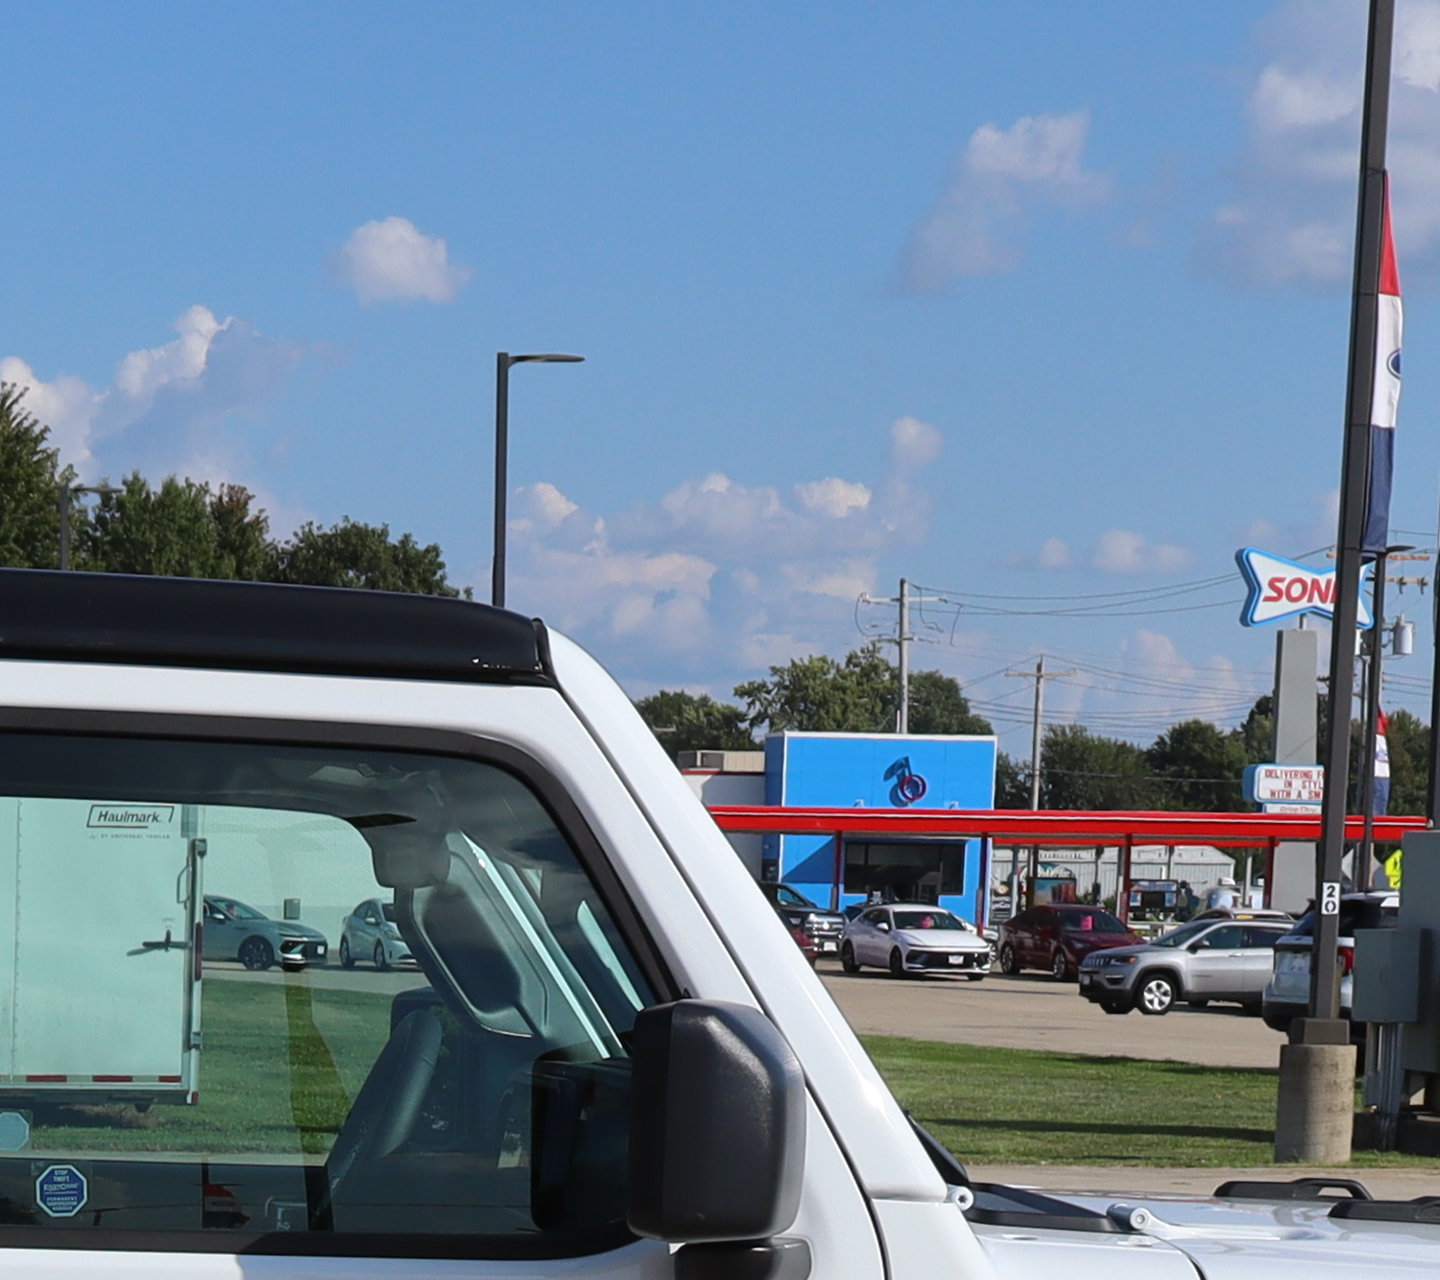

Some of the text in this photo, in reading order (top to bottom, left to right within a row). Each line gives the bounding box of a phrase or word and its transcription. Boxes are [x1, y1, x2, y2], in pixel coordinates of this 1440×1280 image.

[1265, 769, 1312, 779] DELIVERING
[1284, 780, 1292, 788] IN
[1270, 790, 1291, 798] WITH
[1296, 790, 1302, 799] A
[98, 810, 161, 823] Haulmark
